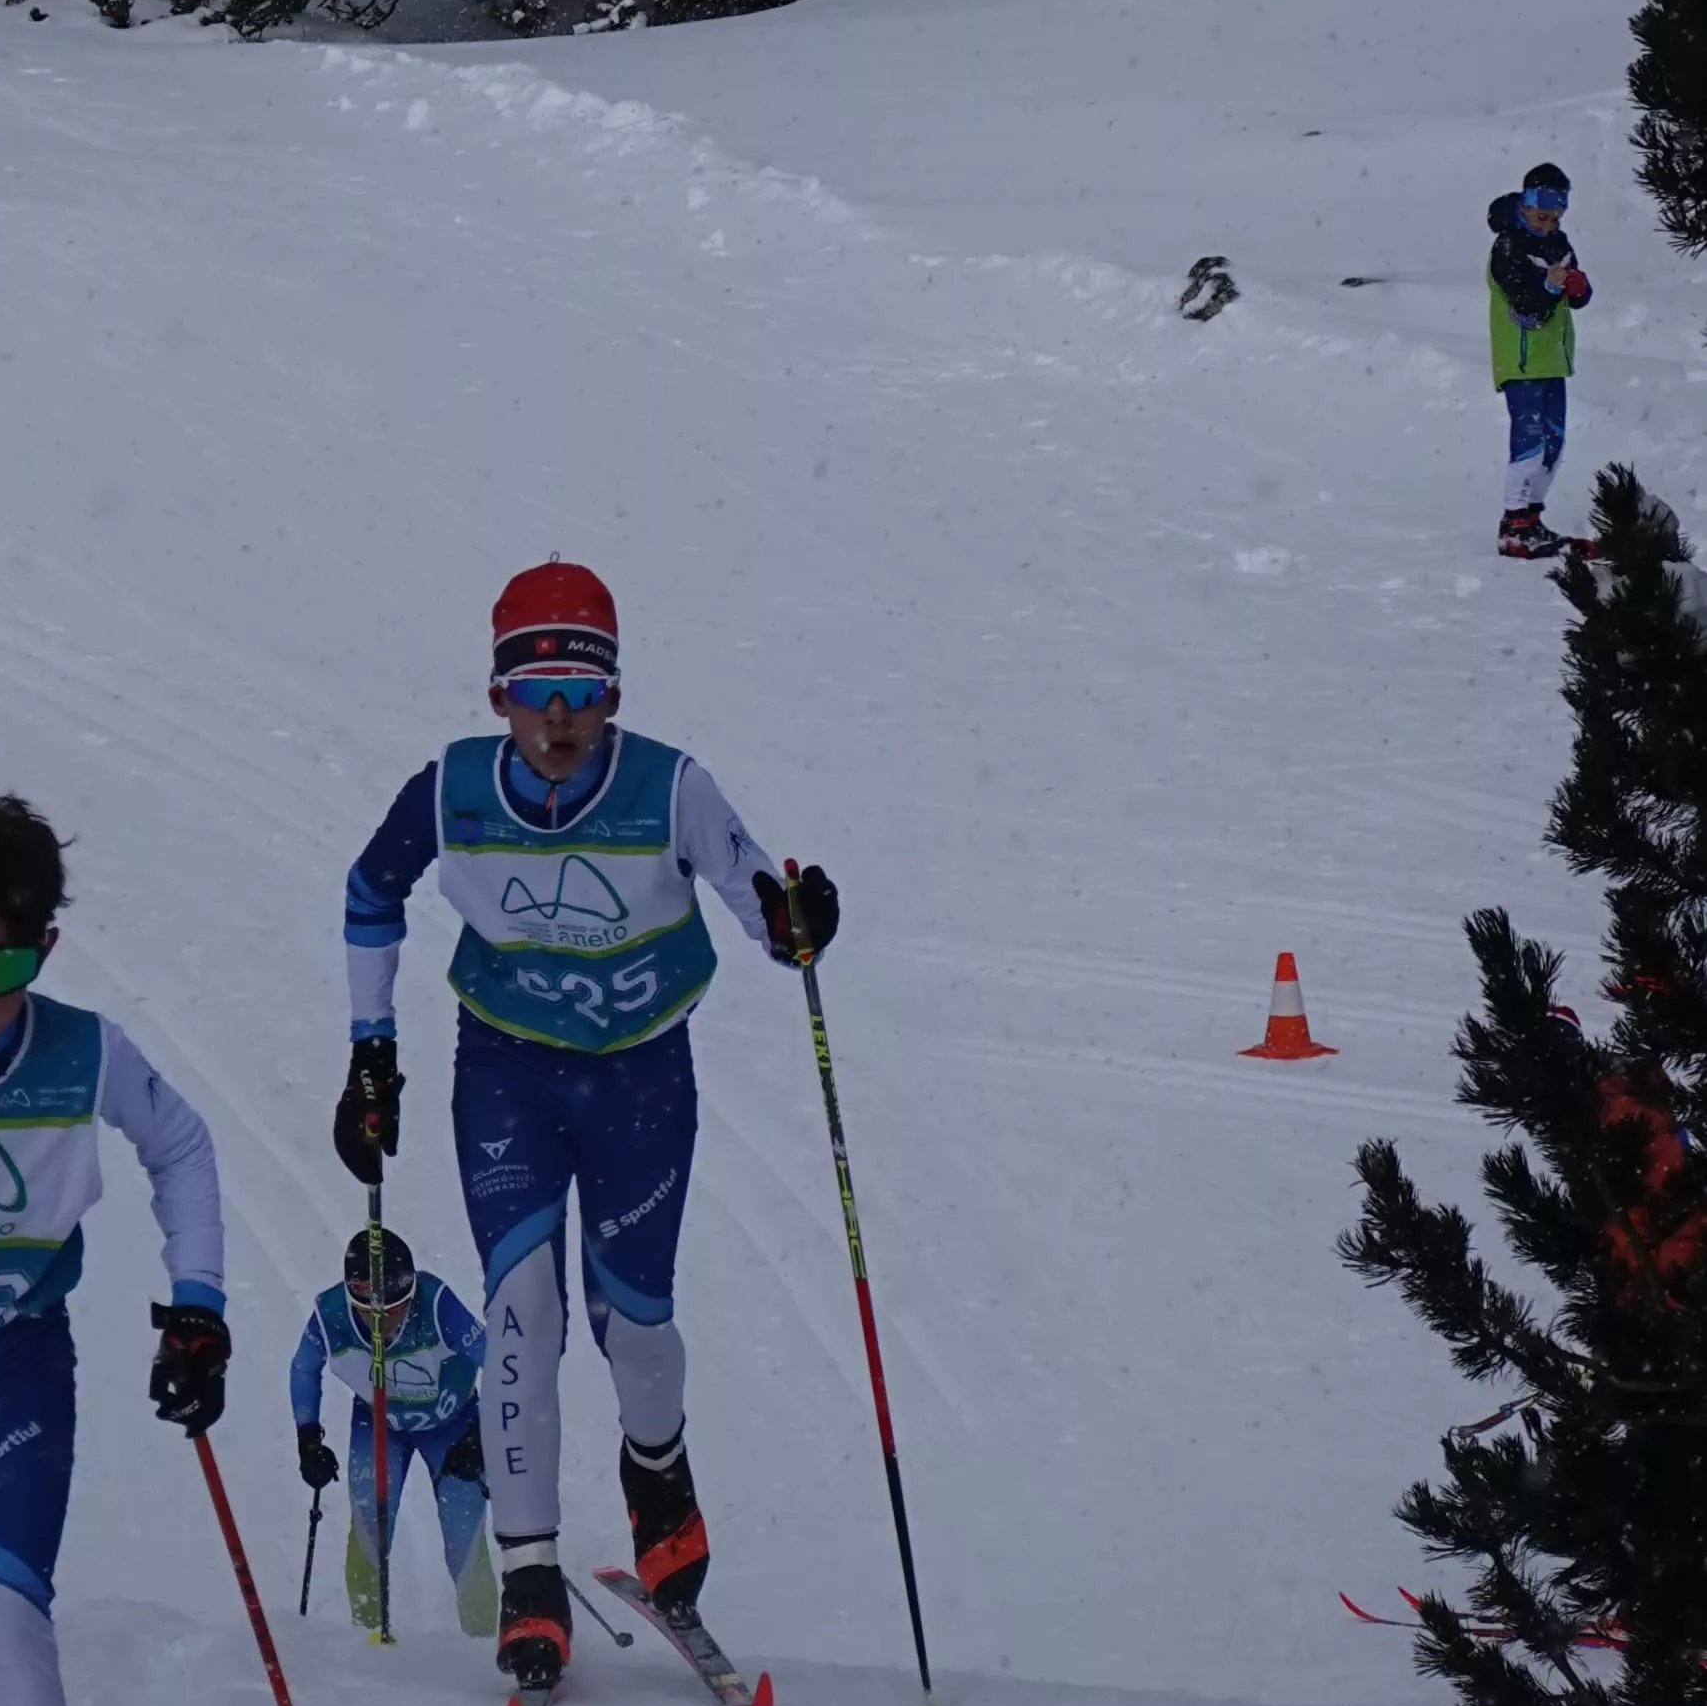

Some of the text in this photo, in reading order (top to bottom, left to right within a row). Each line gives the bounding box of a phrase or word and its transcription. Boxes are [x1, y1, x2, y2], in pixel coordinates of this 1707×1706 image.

[558, 925, 628, 948] aneto
[360, 1069, 376, 1100] LEKI
[619, 1166, 678, 1227] sportful
[501, 1304, 528, 1475] ASPE
